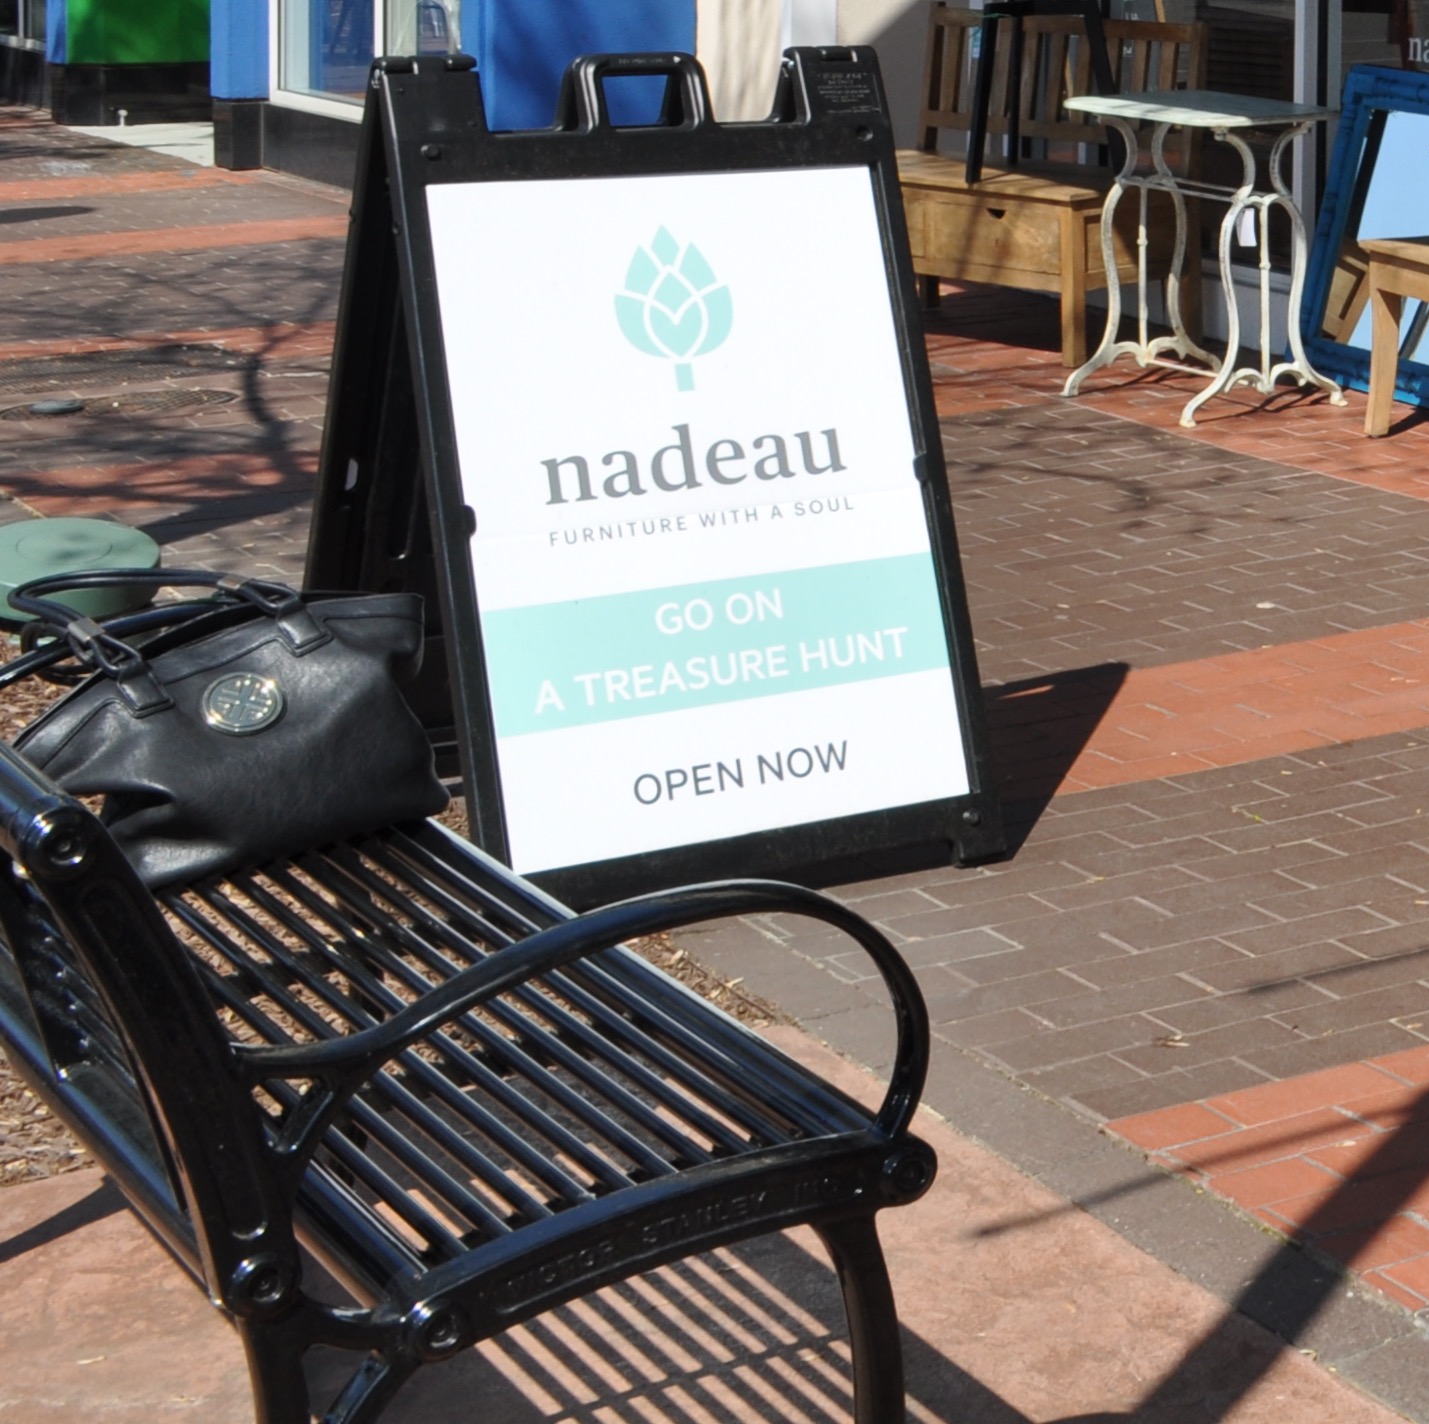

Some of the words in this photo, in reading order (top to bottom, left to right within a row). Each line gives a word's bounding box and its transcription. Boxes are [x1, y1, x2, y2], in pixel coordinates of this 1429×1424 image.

[539, 422, 848, 506] nadeau
[547, 515, 690, 548] FURNITURE
[698, 507, 761, 529] WITH
[769, 503, 786, 519] A
[793, 496, 856, 516] SOUL
[653, 599, 714, 636] GO
[724, 588, 784, 627] ON
[534, 680, 566, 715] A
[573, 644, 791, 707] TREASURE
[799, 626, 909, 670] HUNT
[632, 757, 746, 807] OPEN
[756, 739, 850, 784] NOW
